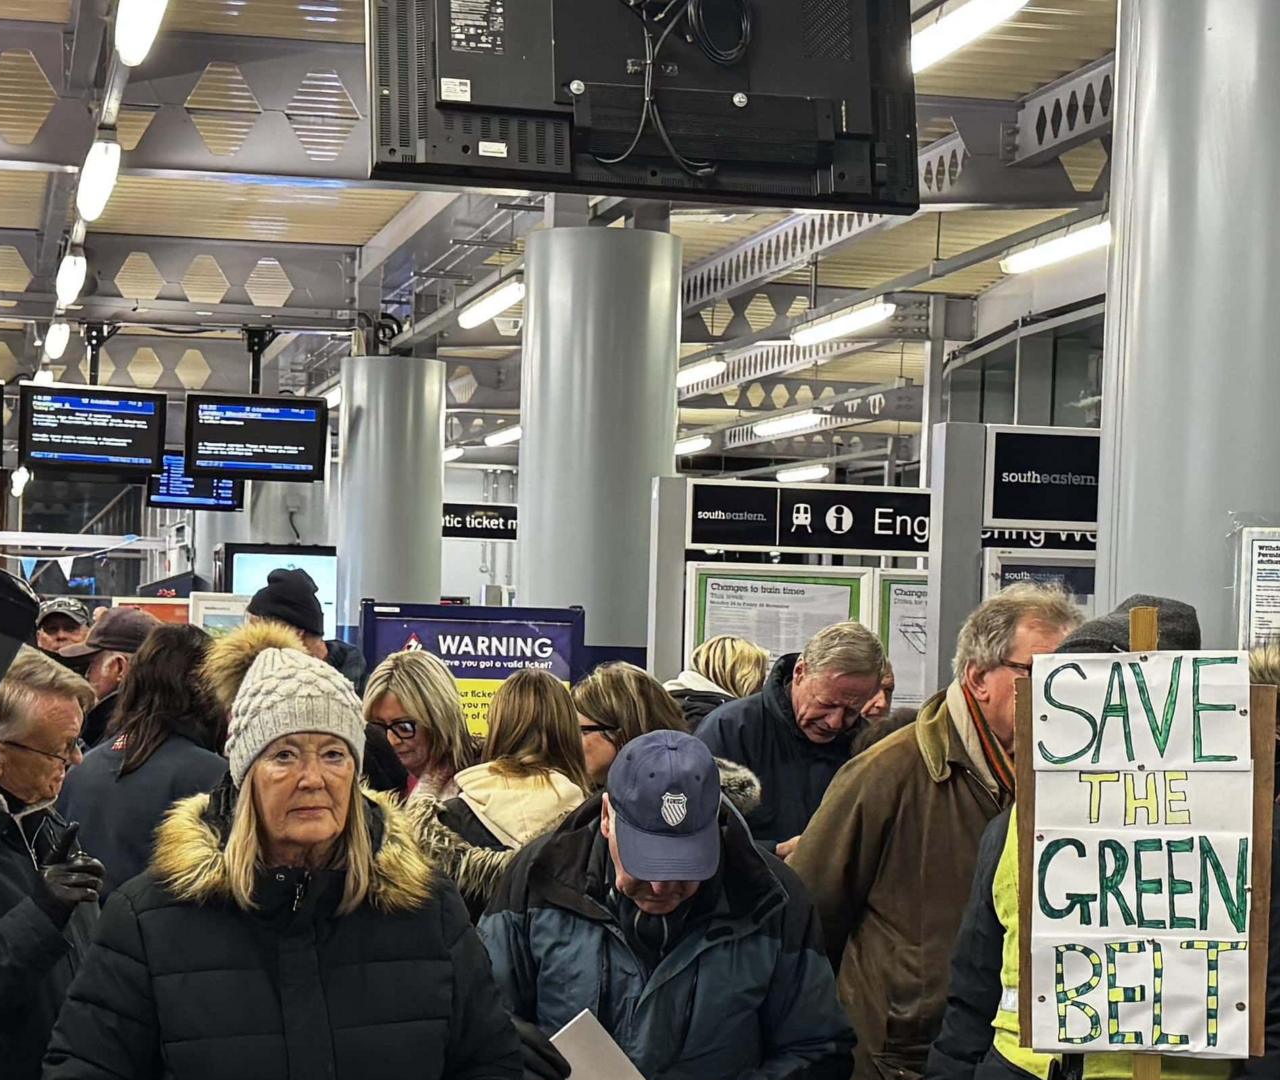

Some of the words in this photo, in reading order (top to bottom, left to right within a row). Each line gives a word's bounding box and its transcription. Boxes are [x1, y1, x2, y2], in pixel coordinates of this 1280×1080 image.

[465, 515, 505, 529] ticket
[710, 582, 748, 594] Changes
[749, 584, 759, 593] to
[760, 585, 781, 595] train
[782, 586, 806, 596] times
[437, 634, 554, 658] WARNING
[461, 661, 478, 669] you
[479, 660, 494, 669] got
[502, 660, 523, 669] valid
[524, 661, 553, 670] ticket?
[1037, 655, 1239, 764] SAVE
[1079, 770, 1192, 826] THE
[1037, 835, 1249, 933] GREEN
[1054, 939, 1248, 1048] BELT
